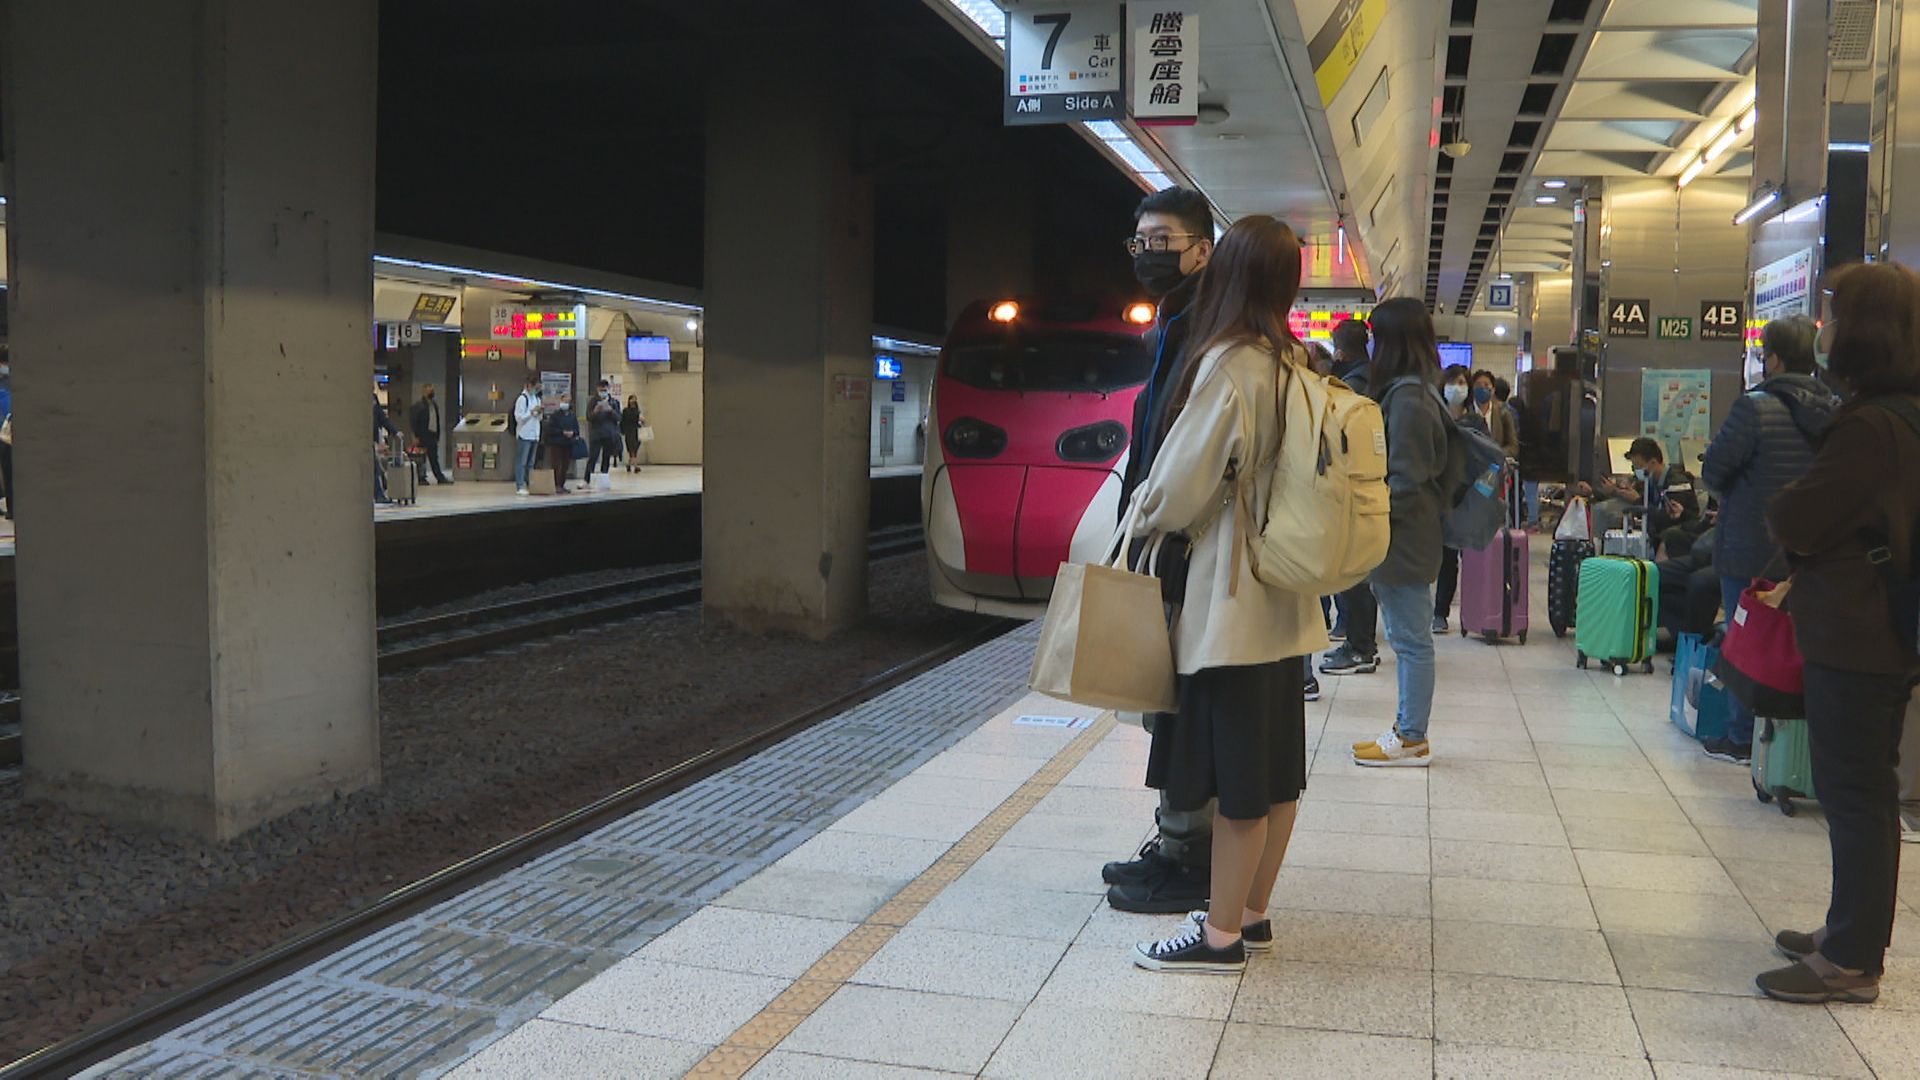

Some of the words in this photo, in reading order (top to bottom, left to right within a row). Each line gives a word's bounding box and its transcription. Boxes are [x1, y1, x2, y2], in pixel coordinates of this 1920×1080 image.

[1033, 13, 1071, 70] 7
[1093, 33, 1111, 52] 車
[1088, 55, 1116, 69] Car
[1149, 11, 1184, 105] 騰雲座艙
[1065, 95, 1099, 111] Side
[1102, 95, 1115, 109] A
[1612, 303, 1645, 323] 4A
[1703, 305, 1738, 325] 4B
[404, 325, 413, 338] 6
[1660, 318, 1689, 338] M25
